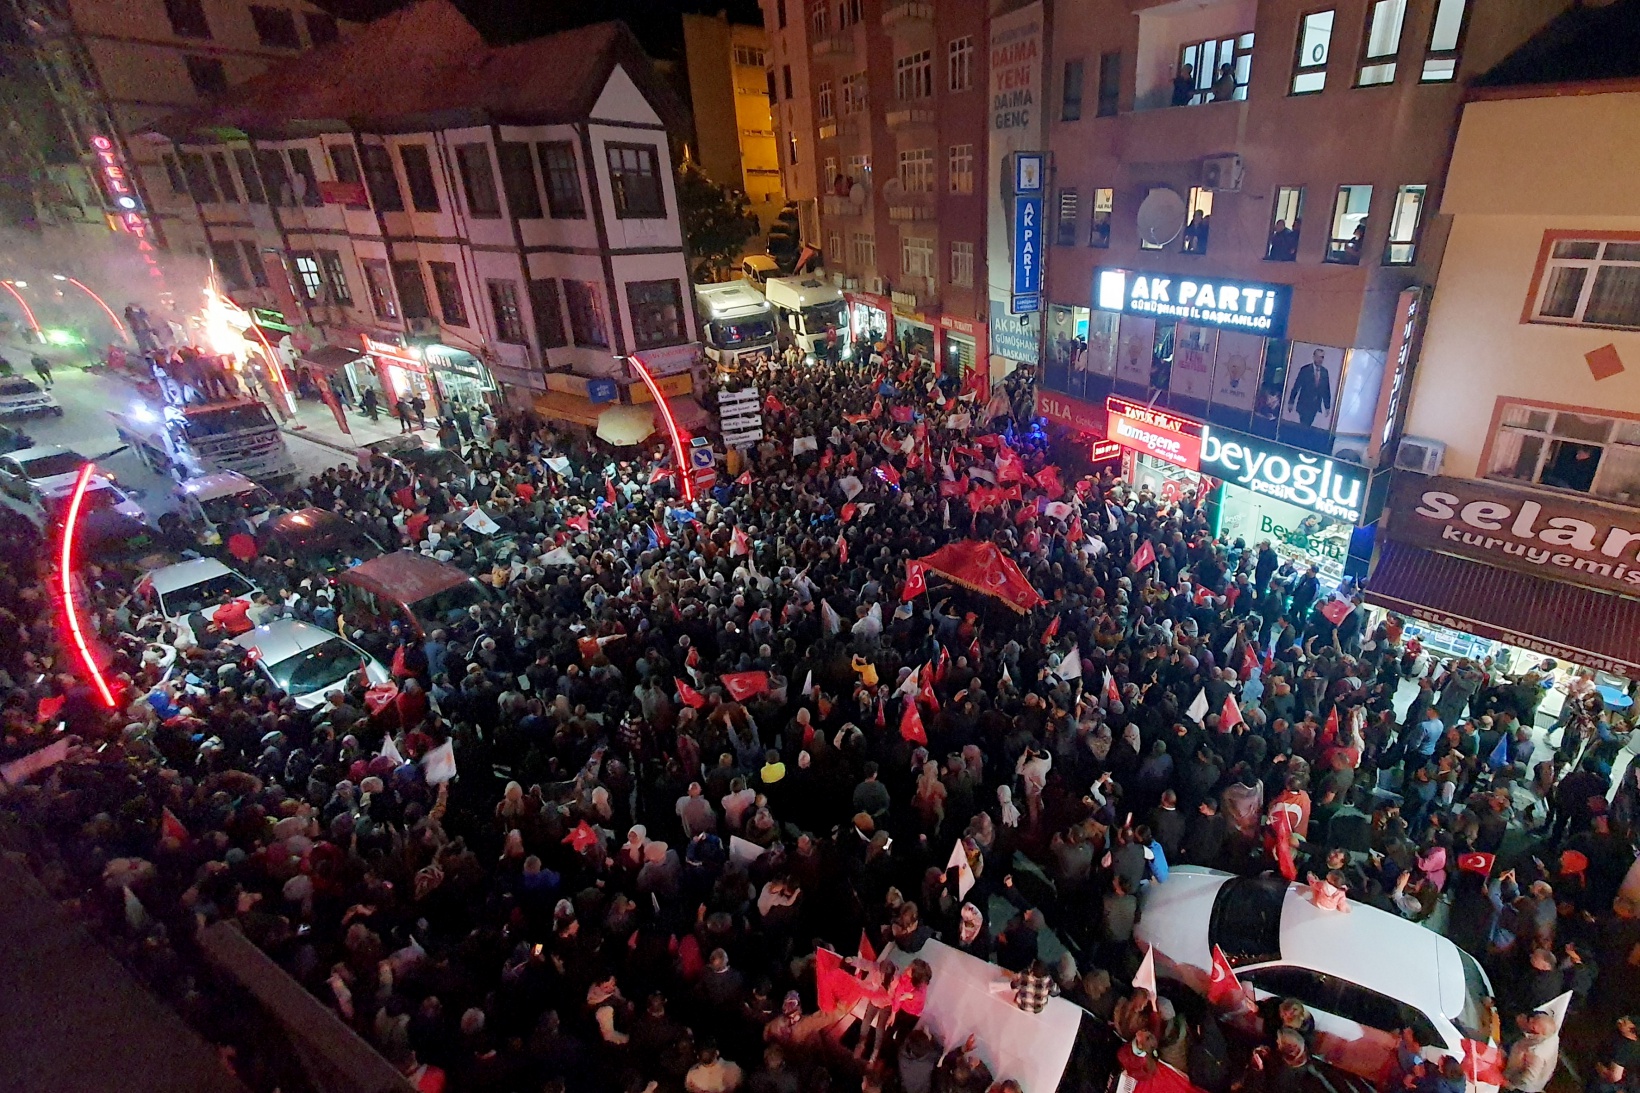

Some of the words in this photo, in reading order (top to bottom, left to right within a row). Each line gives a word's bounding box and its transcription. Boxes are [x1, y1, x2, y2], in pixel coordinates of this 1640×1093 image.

[995, 109, 1030, 130] GENÇ
[93, 135, 129, 194] OTEL
[1023, 202, 1035, 227] AK
[1023, 229, 1035, 289] PARTİ
[1131, 276, 1171, 302] AK
[1179, 281, 1276, 316] PARTİ
[995, 318, 1009, 333] AK
[1131, 299, 1190, 318] GÜMÜŞHANE
[1190, 306, 1201, 319] İL
[1202, 310, 1272, 329] BAŞKANLIĞI
[995, 334, 1040, 352] GÜMÜŞHANE
[1041, 398, 1072, 421] SILA
[1116, 418, 1181, 453] komagene
[1200, 424, 1361, 508] beyoğlu
[1315, 494, 1360, 523] köme
[1260, 514, 1344, 560] Beyoğlu
[1411, 607, 1475, 633] SELAM
